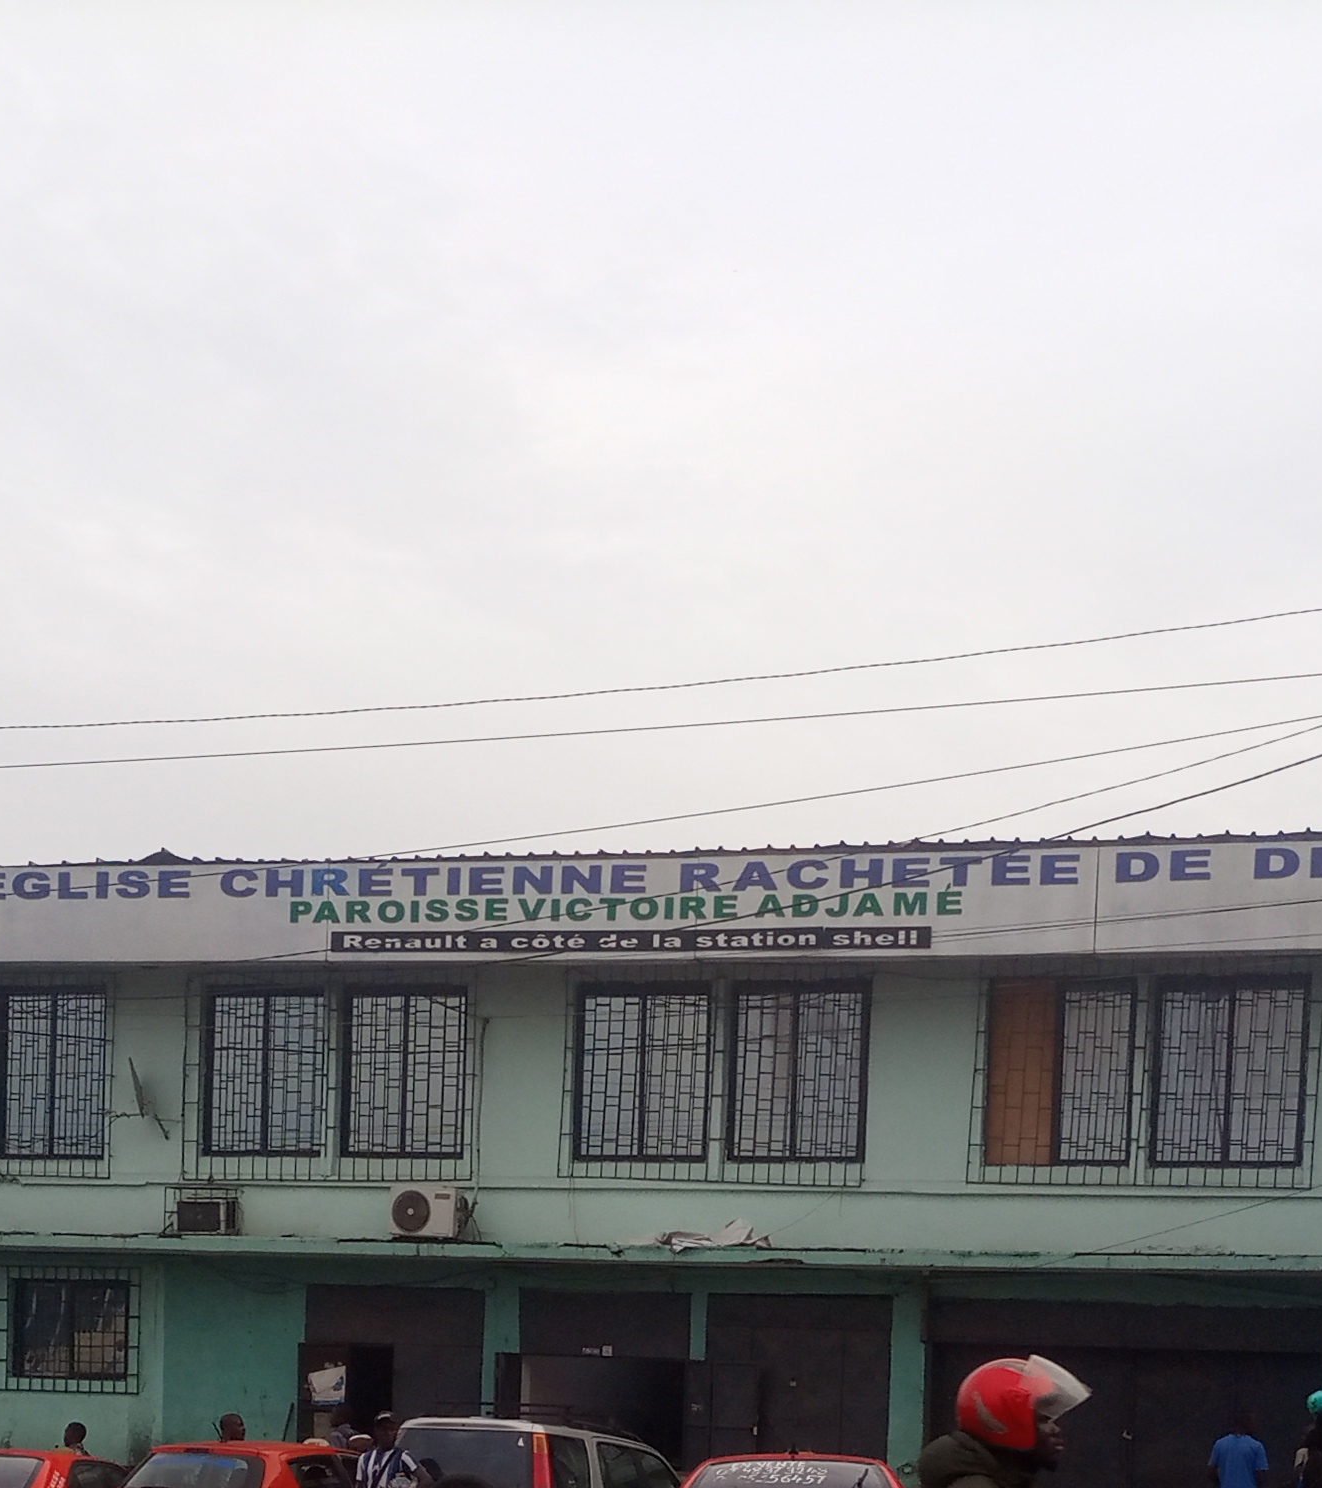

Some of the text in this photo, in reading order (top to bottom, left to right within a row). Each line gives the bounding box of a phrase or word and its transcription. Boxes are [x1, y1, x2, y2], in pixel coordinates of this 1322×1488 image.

[220, 861, 647, 897] CHRÉTIENNE
[1115, 849, 1212, 883] DE
[290, 882, 963, 923] PAROISSE VICTOIRE ADJAMÉ
[343, 933, 467, 950] Renault
[511, 933, 586, 949] côté
[599, 933, 638, 949] de
[652, 933, 680, 948] la
[695, 931, 816, 948] station
[832, 929, 918, 946] shell
